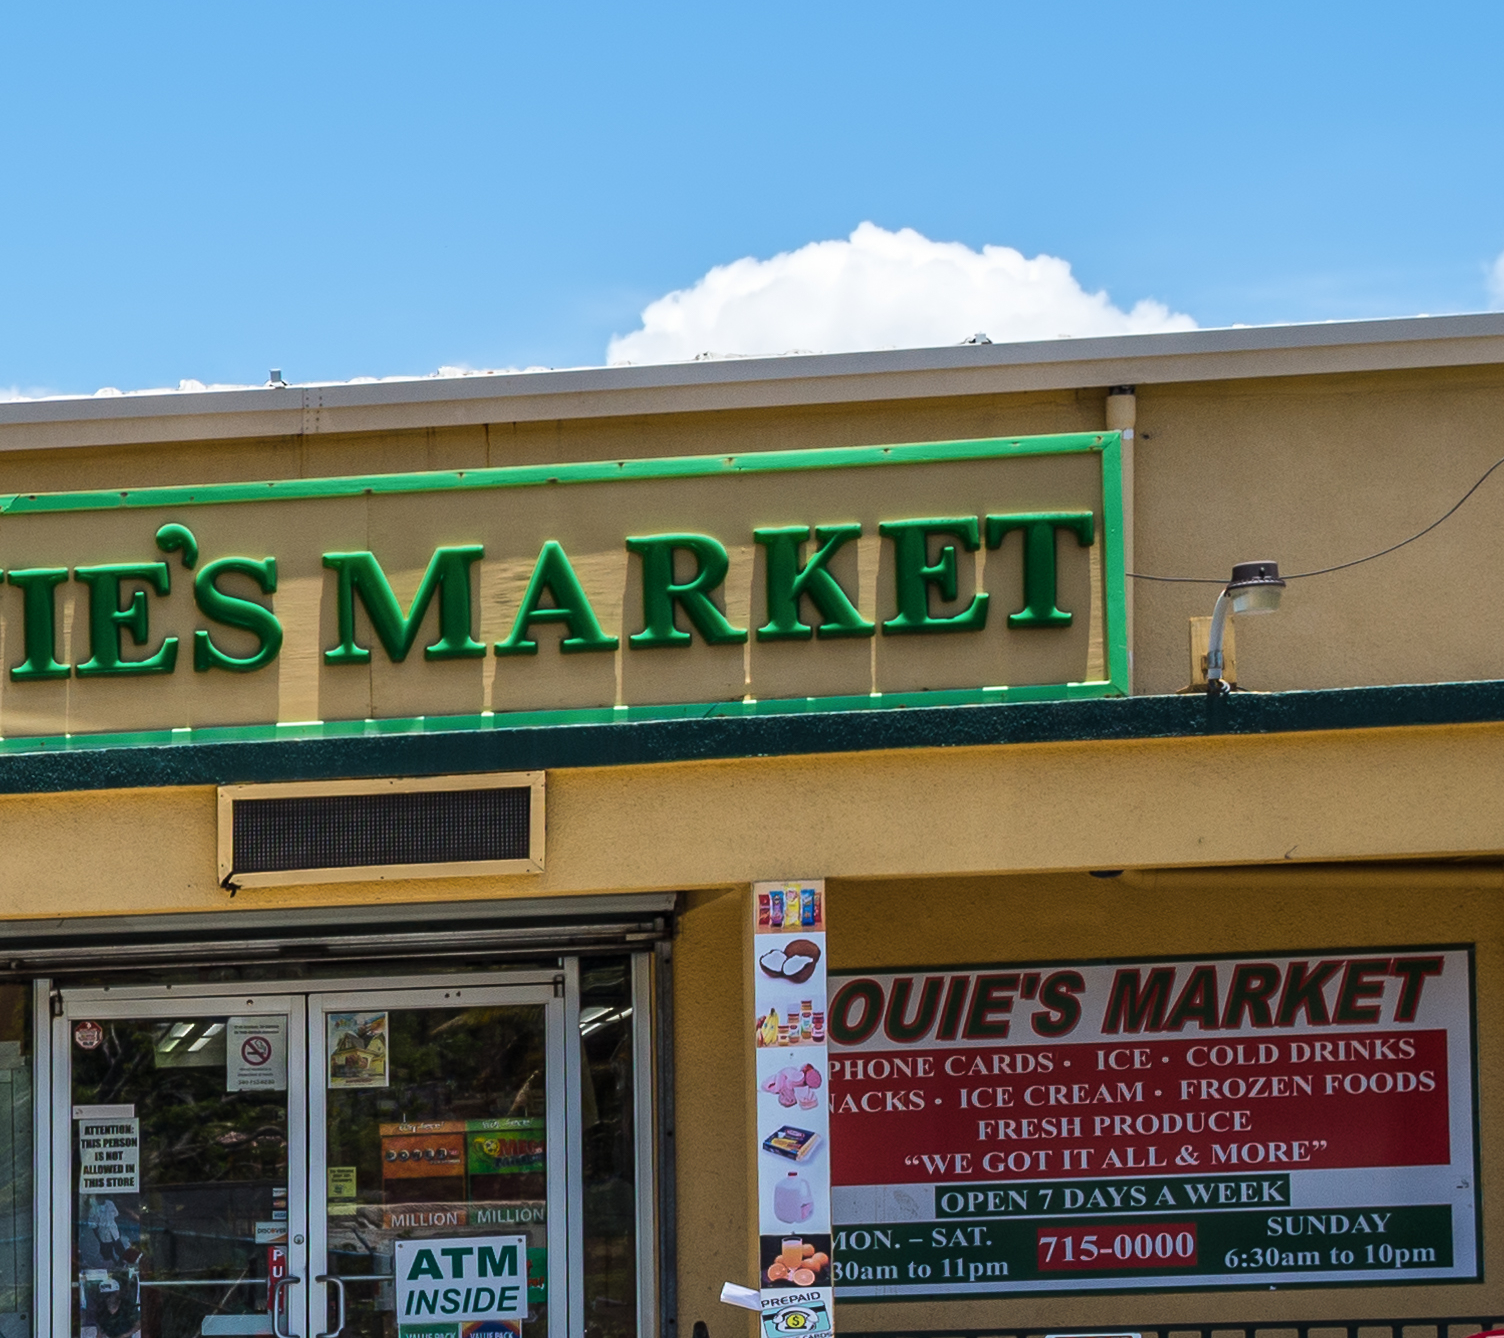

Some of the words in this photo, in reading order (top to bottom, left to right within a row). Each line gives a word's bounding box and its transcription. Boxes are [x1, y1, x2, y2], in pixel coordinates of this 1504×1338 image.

[322, 511, 1094, 665] MARKET
[1101, 955, 1445, 1035] MARKET
[828, 1056, 935, 1081] PHONE
[944, 1051, 1054, 1077] CARDS
[1095, 1048, 1153, 1071] ICE
[1186, 1042, 1280, 1068] COLD
[1289, 1037, 1417, 1064] DRINKS
[958, 1086, 1014, 1109] ICE
[1023, 1082, 1145, 1106] CREAM
[1179, 1074, 1314, 1101] FROZEN
[1324, 1070, 1437, 1096] FOODS
[84, 1125, 134, 1135] ATTENTION:
[977, 1116, 1082, 1142] FRESH
[1093, 1110, 1252, 1137] PRODUCE
[81, 1139, 101, 1149] THIS
[103, 1138, 137, 1148] PERSON
[95, 1152, 104, 1161] IS
[106, 1151, 123, 1161] NOT
[83, 1165, 124, 1174] ALLOWED
[125, 1164, 135, 1174] IN
[904, 1152, 974, 1176] “WE
[982, 1149, 1052, 1173] GOT
[1061, 1148, 1096, 1171] IT
[1101, 1146, 1168, 1169] ALL
[1174, 1144, 1201, 1166] &
[1210, 1139, 1328, 1165] MORE”
[84, 1178, 104, 1188] THIS
[106, 1177, 134, 1187] STORE
[941, 1190, 1029, 1213] OPEN
[1038, 1189, 1052, 1210] 7
[1063, 1185, 1148, 1209] DAYS
[1155, 1186, 1178, 1207] A
[1184, 1180, 1286, 1204] WEEK
[392, 1212, 458, 1228] MILLION
[477, 1208, 544, 1224] MILLION
[1267, 1213, 1392, 1237] SUNDAY
[931, 1227, 993, 1249] SAT.
[1038, 1232, 1195, 1263] 715-0000
[407, 1245, 518, 1280] ATM
[1225, 1248, 1320, 1268] 6:30am
[1330, 1248, 1354, 1265] to
[1364, 1243, 1437, 1270] 10pm
[832, 1261, 899, 1282] 30am
[908, 1261, 932, 1279] to
[942, 1257, 1010, 1284] 11pm
[405, 1286, 520, 1315] INSIDE
[761, 1291, 821, 1308] PREPAID
